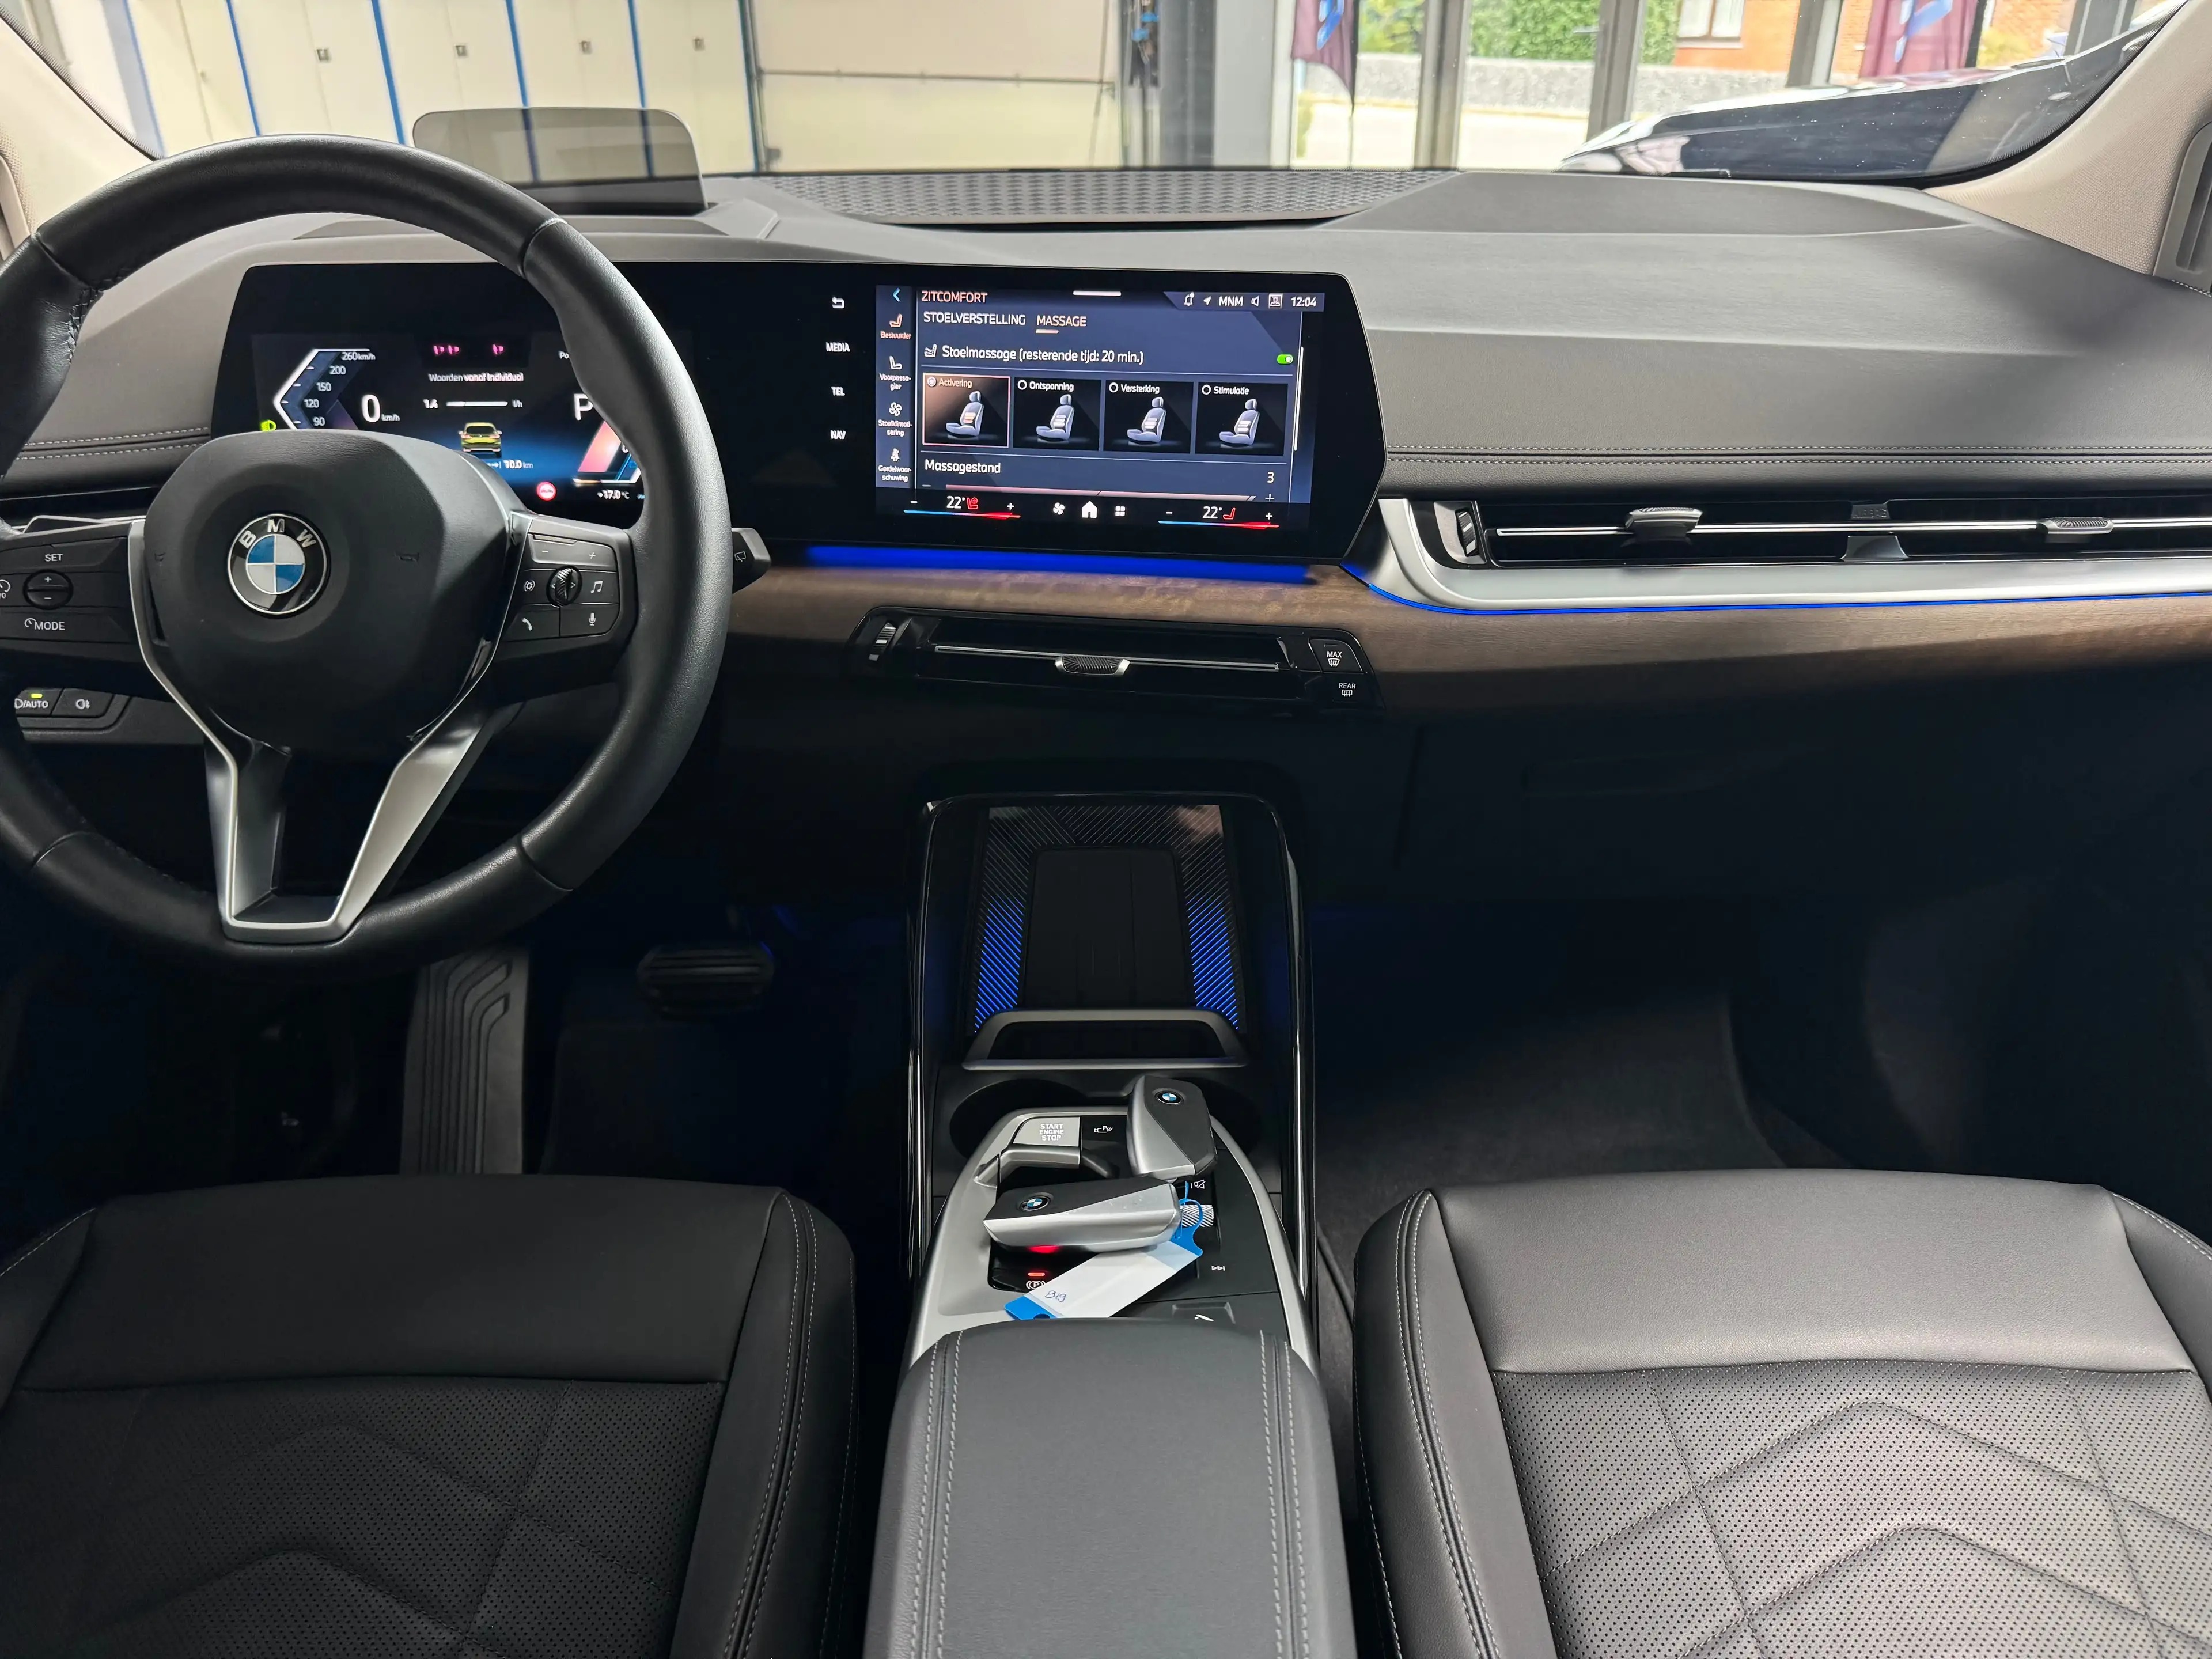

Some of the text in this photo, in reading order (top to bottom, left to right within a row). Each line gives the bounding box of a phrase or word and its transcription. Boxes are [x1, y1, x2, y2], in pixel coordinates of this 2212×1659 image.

[922, 291, 988, 303] ZITCOMFORT
[1219, 296, 1243, 306] MNM
[1291, 297, 1316, 306] 12:04
[923, 311, 1026, 325] STOELVERSTELLING
[1037, 315, 1086, 327] MASSAGE
[880, 331, 911, 339] Bestuurder
[825, 342, 850, 352] MEDIA
[342, 352, 358, 361] 260
[942, 345, 1143, 365] Stoelmassage (resterende tijd: 20 min.)
[330, 366, 346, 375] 200
[429, 373, 463, 382] Waarden
[464, 373, 486, 381] vanaf
[317, 382, 332, 392] 150
[938, 378, 972, 389] Activering
[1029, 381, 1074, 392] Ontspanning
[1120, 384, 1160, 393] Versterking
[831, 387, 845, 396] TEL
[1214, 386, 1249, 395] Stimulatie
[304, 399, 320, 408] 120
[361, 394, 381, 422] 0
[574, 393, 594, 421] P
[313, 416, 325, 426] 90
[830, 430, 846, 440] NAV
[887, 429, 904, 437] sering
[925, 459, 1001, 475] Massagestand
[882, 474, 908, 483] schuwing
[1267, 472, 1274, 483] 3
[238, 519, 316, 548] BMW
[44, 554, 63, 562] SET
[35, 622, 65, 631] MODE
